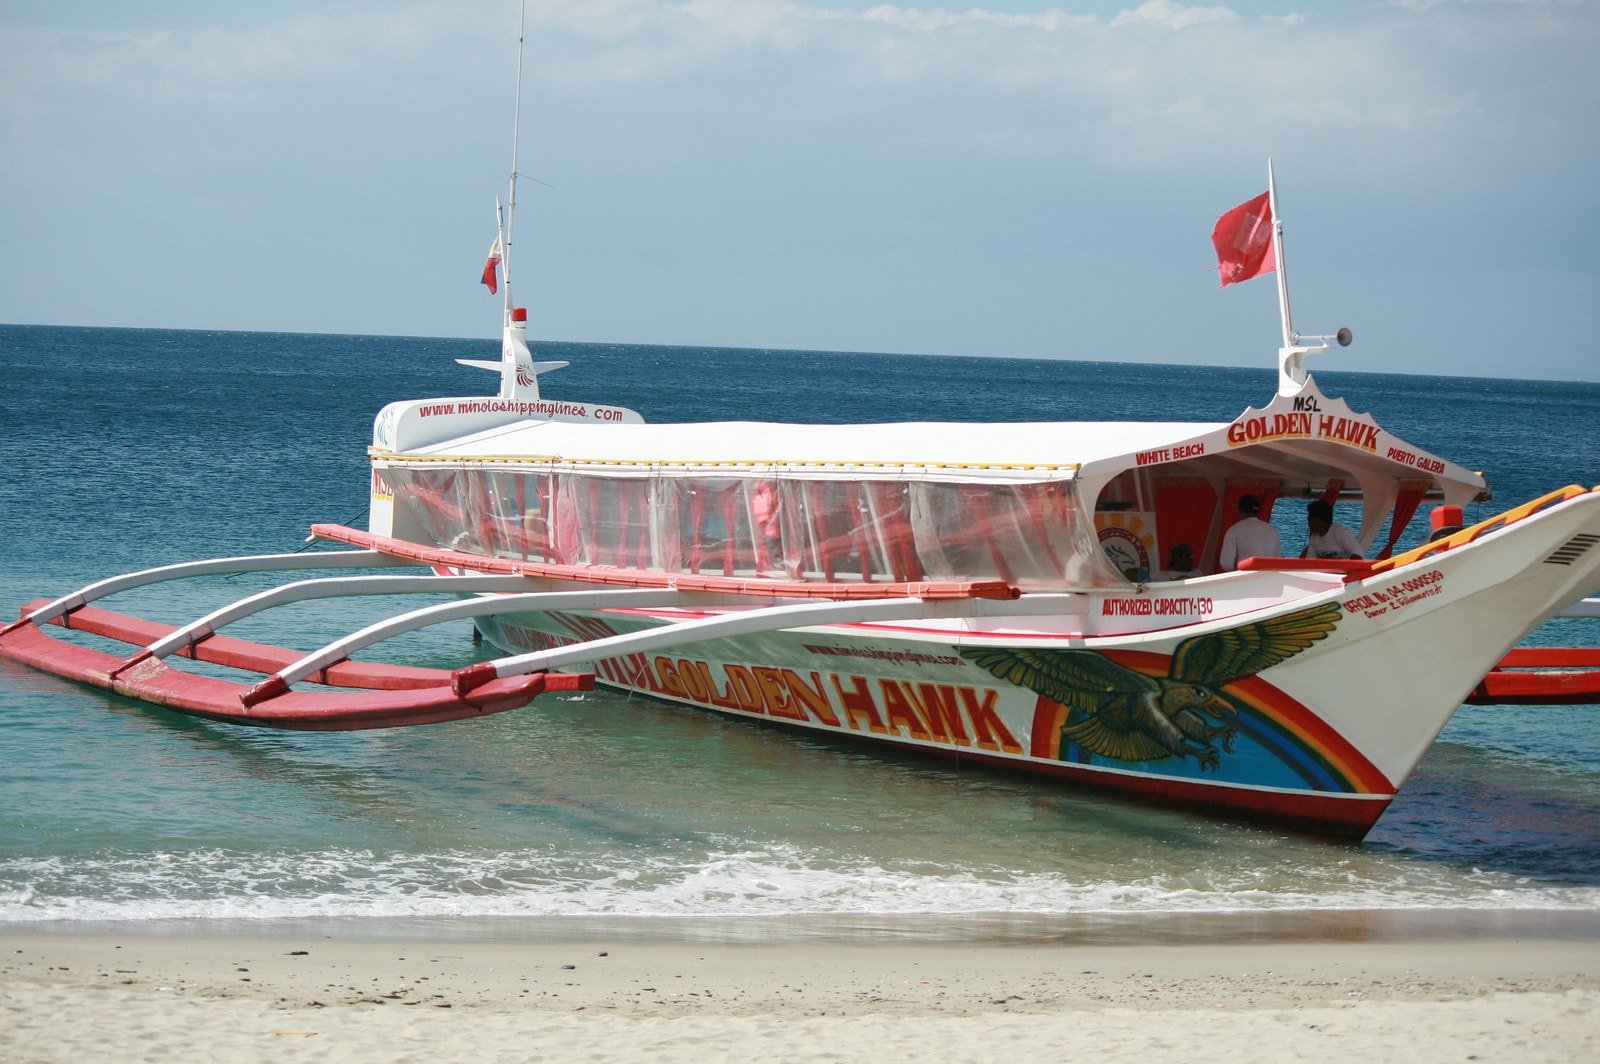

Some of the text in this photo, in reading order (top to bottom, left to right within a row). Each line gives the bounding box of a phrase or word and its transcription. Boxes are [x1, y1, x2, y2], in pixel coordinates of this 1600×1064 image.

[1293, 395, 1321, 412] MSL
[1226, 413, 1381, 453] GOLDEN HAWK
[1135, 443, 1204, 466] WHITE BEACH
[1386, 447, 1445, 475] PUERTO GALERA
[1102, 598, 1152, 616] AUTHORIZED
[1342, 594, 1378, 613] OFFICIAL
[653, 654, 841, 728] GOLDEN
[828, 672, 1025, 756] HAWK
